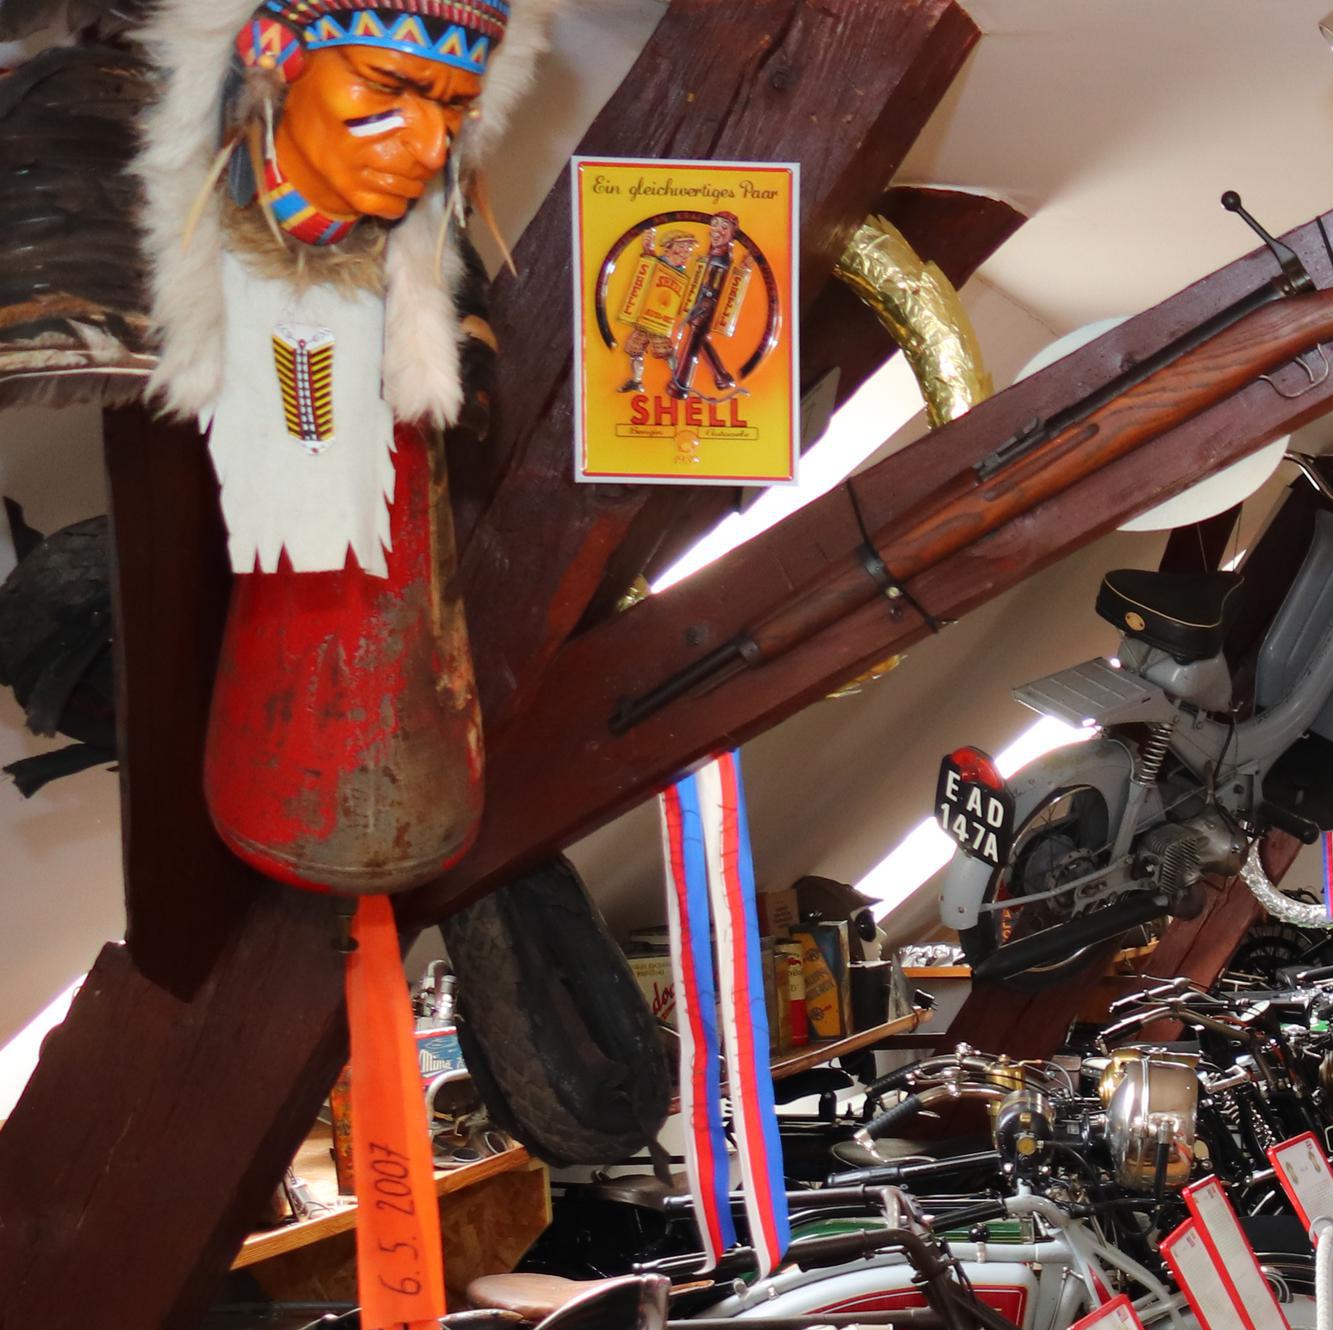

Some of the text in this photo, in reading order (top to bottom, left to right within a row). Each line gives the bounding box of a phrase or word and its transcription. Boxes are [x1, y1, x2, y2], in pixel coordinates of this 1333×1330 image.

[593, 175, 778, 201] Ein gleichwertiges Paar
[624, 264, 649, 316] SHELL
[631, 394, 748, 427] SHELL
[940, 803, 999, 863] 147A
[369, 1142, 415, 1216] 2007
[378, 1271, 421, 1295] 6.
